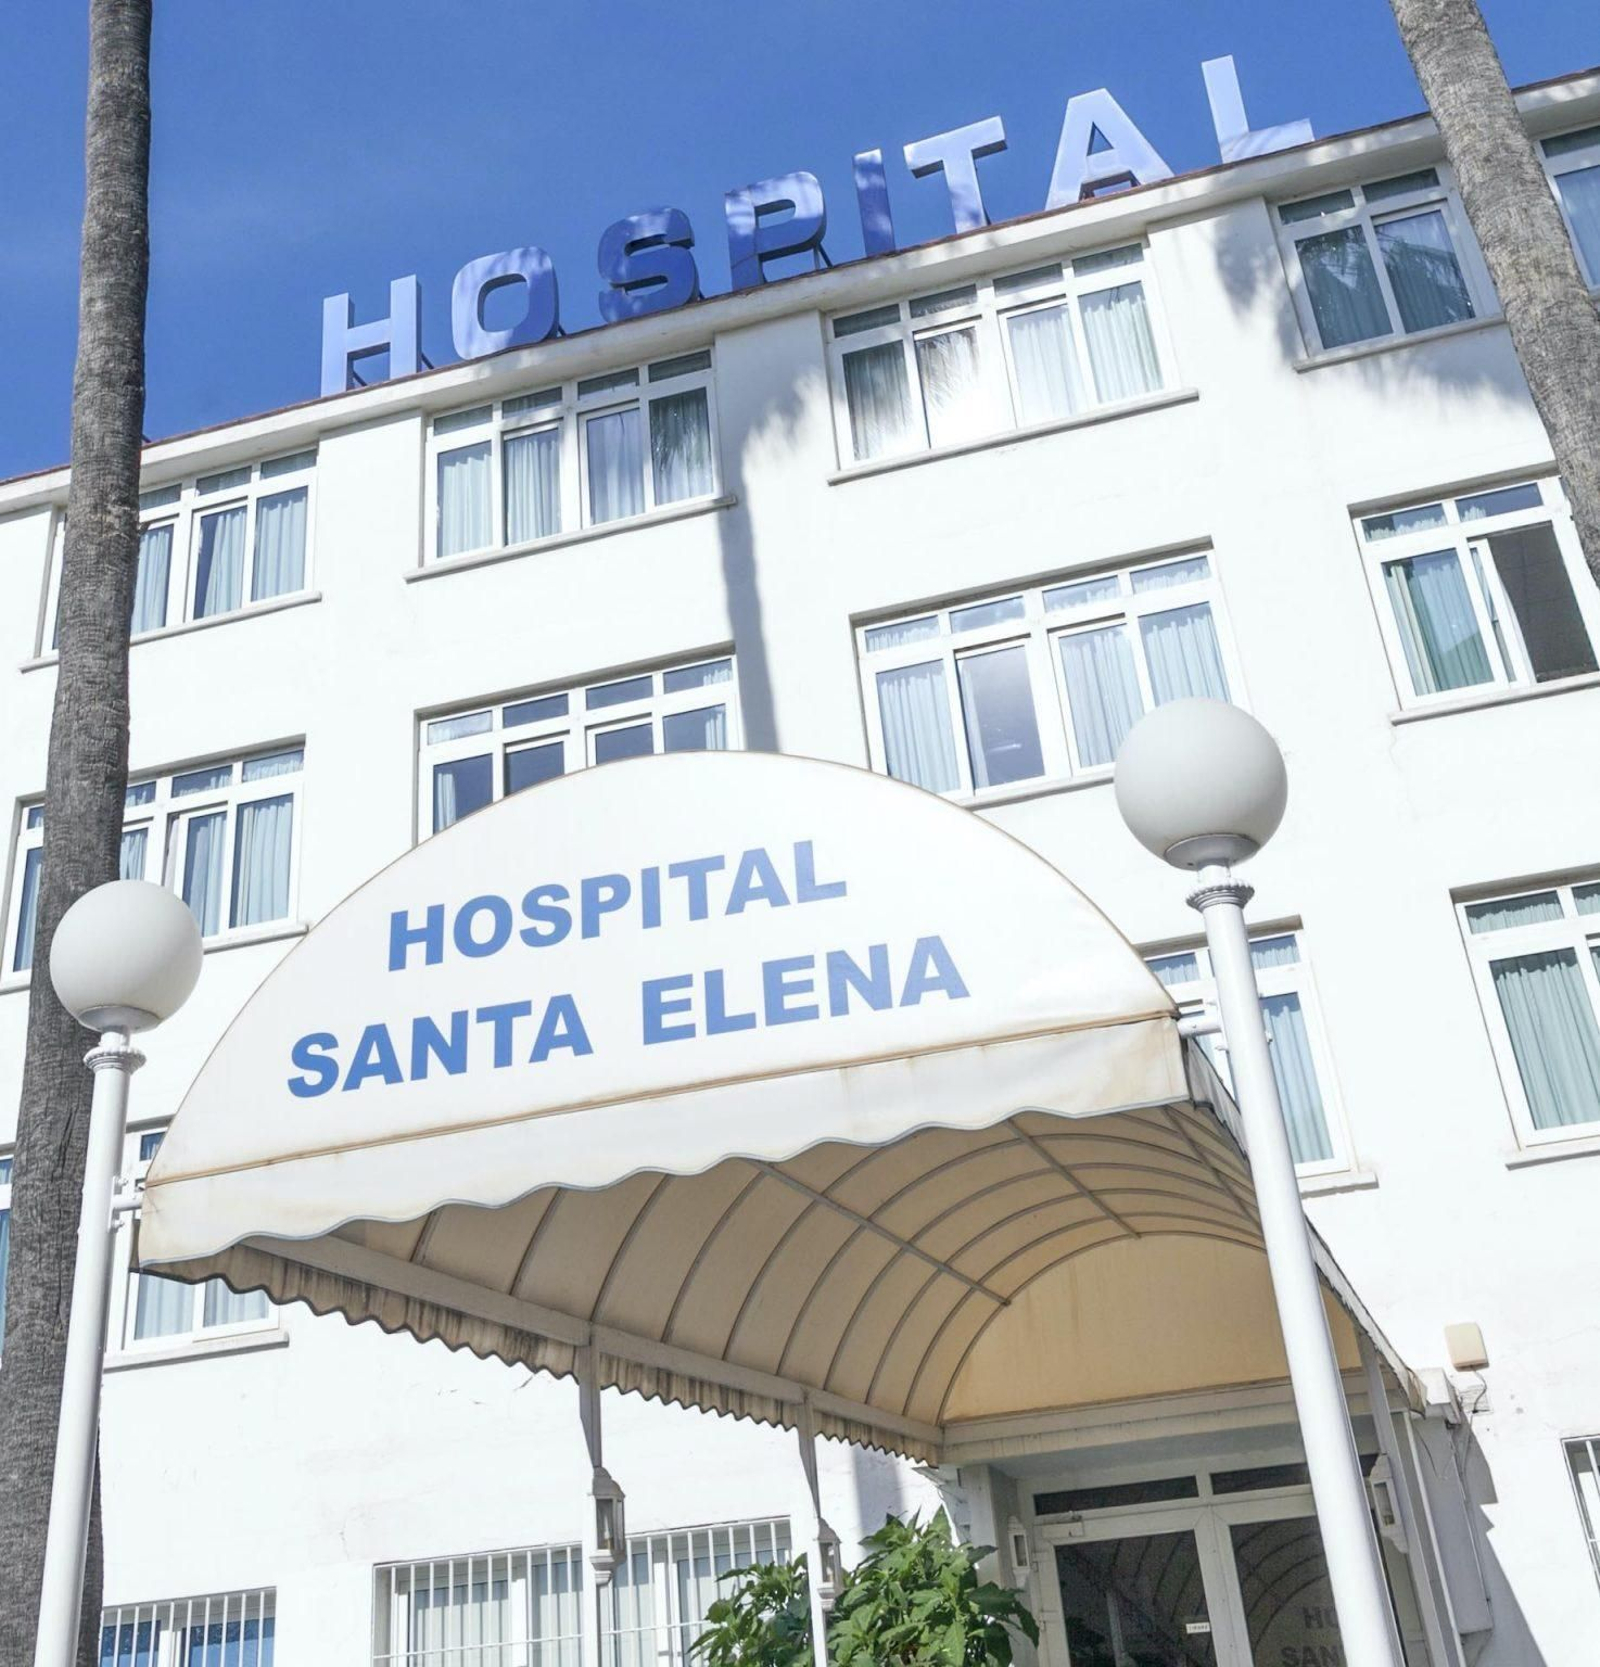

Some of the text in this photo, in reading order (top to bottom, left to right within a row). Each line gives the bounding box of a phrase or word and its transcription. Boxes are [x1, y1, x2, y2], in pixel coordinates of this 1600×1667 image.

[320, 54, 1315, 398] HOSPITAL
[388, 839, 847, 973] HOSPITAL
[287, 934, 971, 1099] SANTA ELENA
